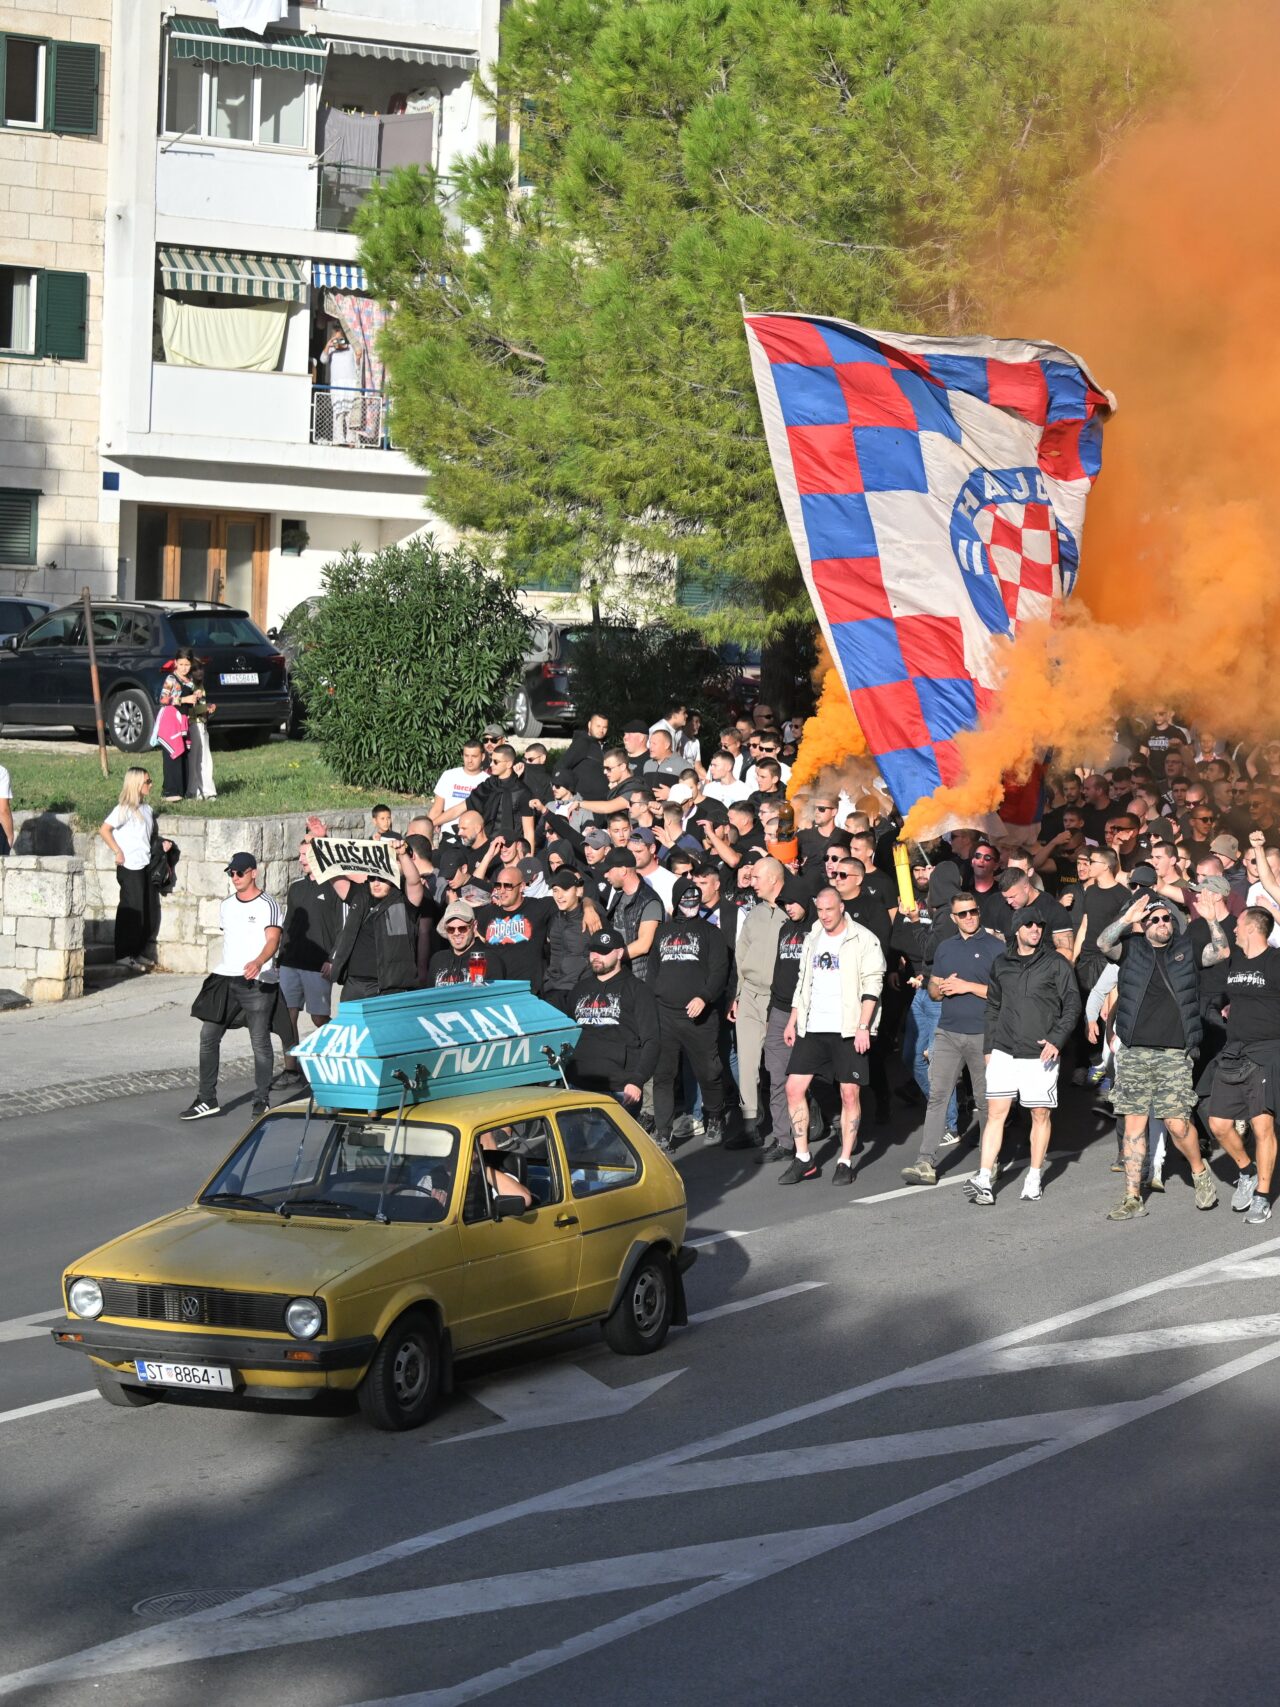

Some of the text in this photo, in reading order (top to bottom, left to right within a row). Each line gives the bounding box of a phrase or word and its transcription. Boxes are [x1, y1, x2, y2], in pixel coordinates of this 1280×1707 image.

[310, 838, 395, 877] KLOŠARI
[489, 920, 525, 938] TORCIDA
[289, 1023, 380, 1087] AJAX
[417, 1004, 531, 1079] AJAX
[147, 1364, 163, 1380] ST
